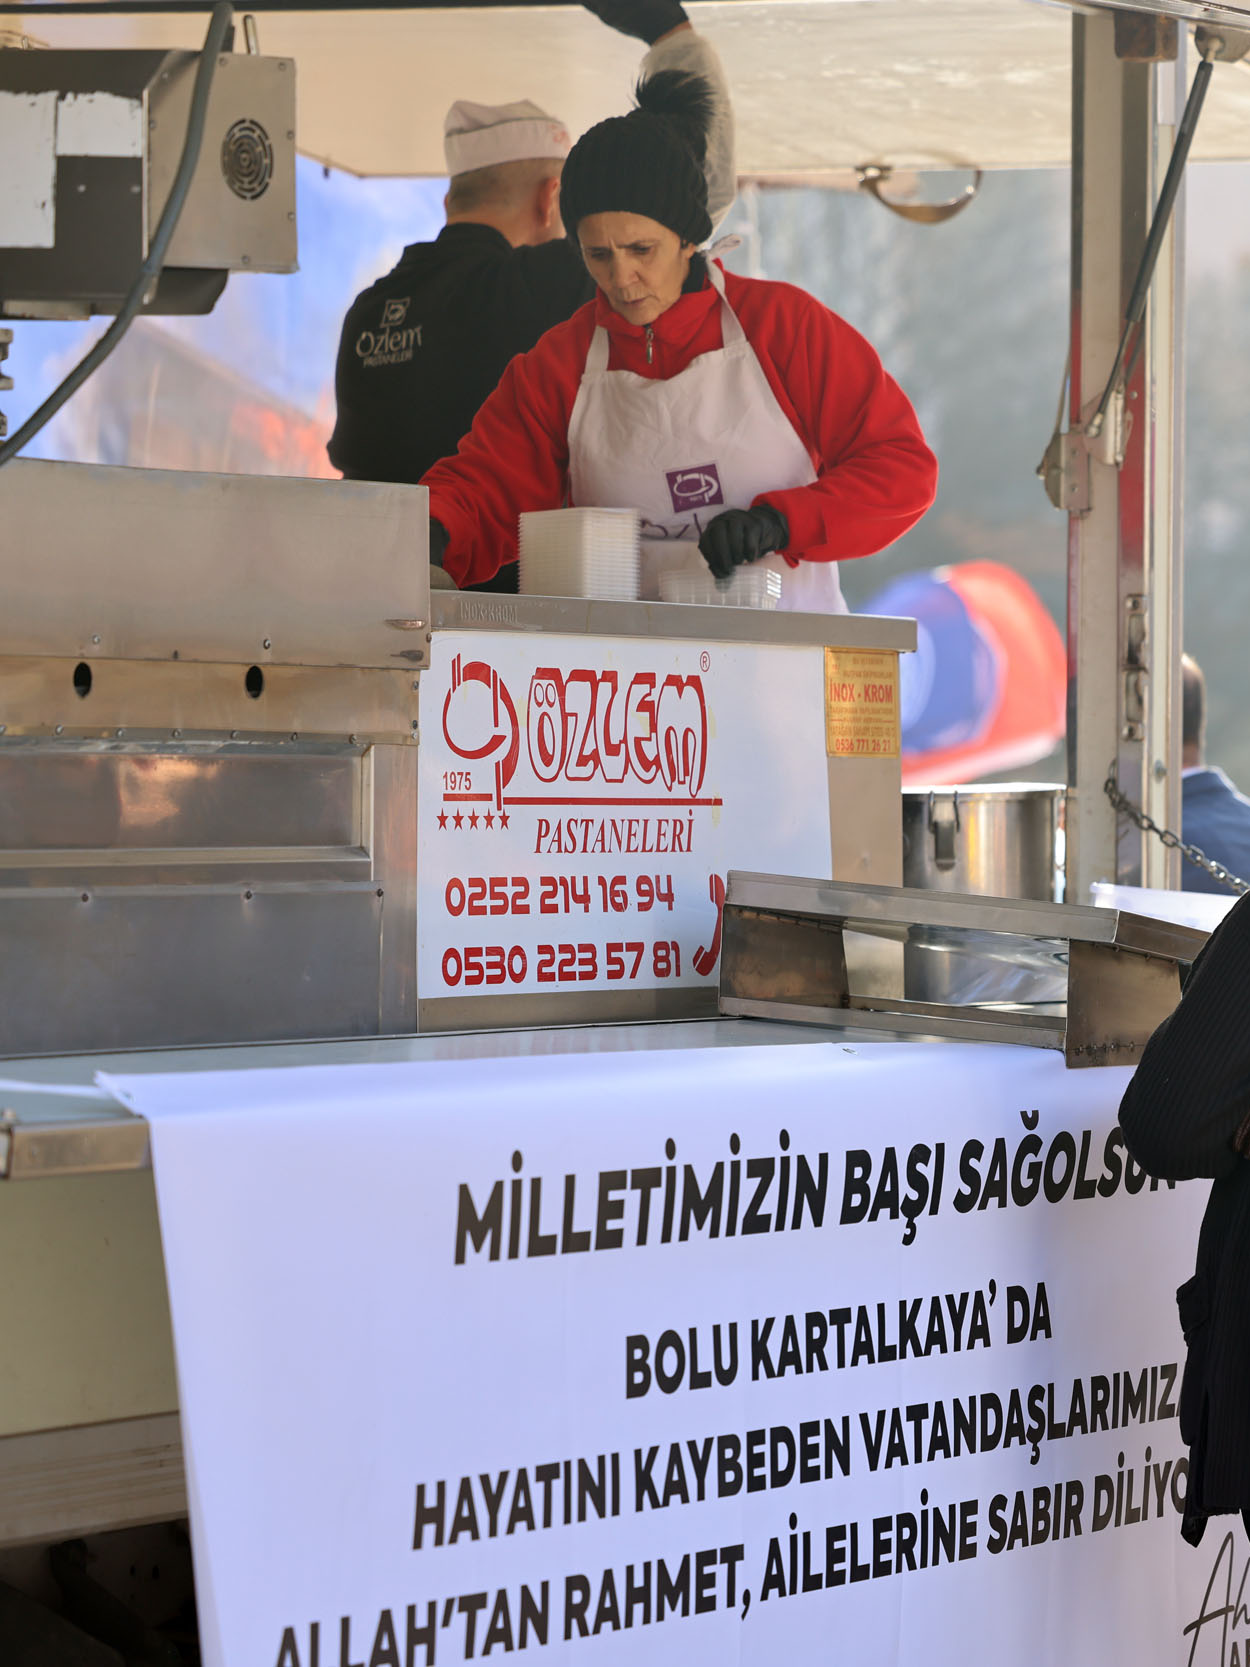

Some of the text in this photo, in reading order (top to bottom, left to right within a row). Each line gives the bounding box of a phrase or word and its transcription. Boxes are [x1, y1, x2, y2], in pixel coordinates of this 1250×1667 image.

[864, 684, 893, 702] KROM
[443, 771, 472, 790] 1975
[534, 809, 695, 853] PASTANELERİ
[445, 874, 675, 917] 0252 214 16 94
[441, 940, 681, 986] 0530 223 57 81
[455, 1109, 1176, 1265] MİLLETİMİZİN BAŞI SAĞOLSU
[626, 1323, 739, 1399] BOLU
[1006, 1282, 1053, 1345] DA
[412, 1363, 1180, 1550] HAYATINI KAYBEDEN VATANDAŞLARIMIZ
[563, 1543, 751, 1641] RAHMET,
[760, 1488, 978, 1602] AİLELERİNE
[986, 1479, 1085, 1555] SABIR
